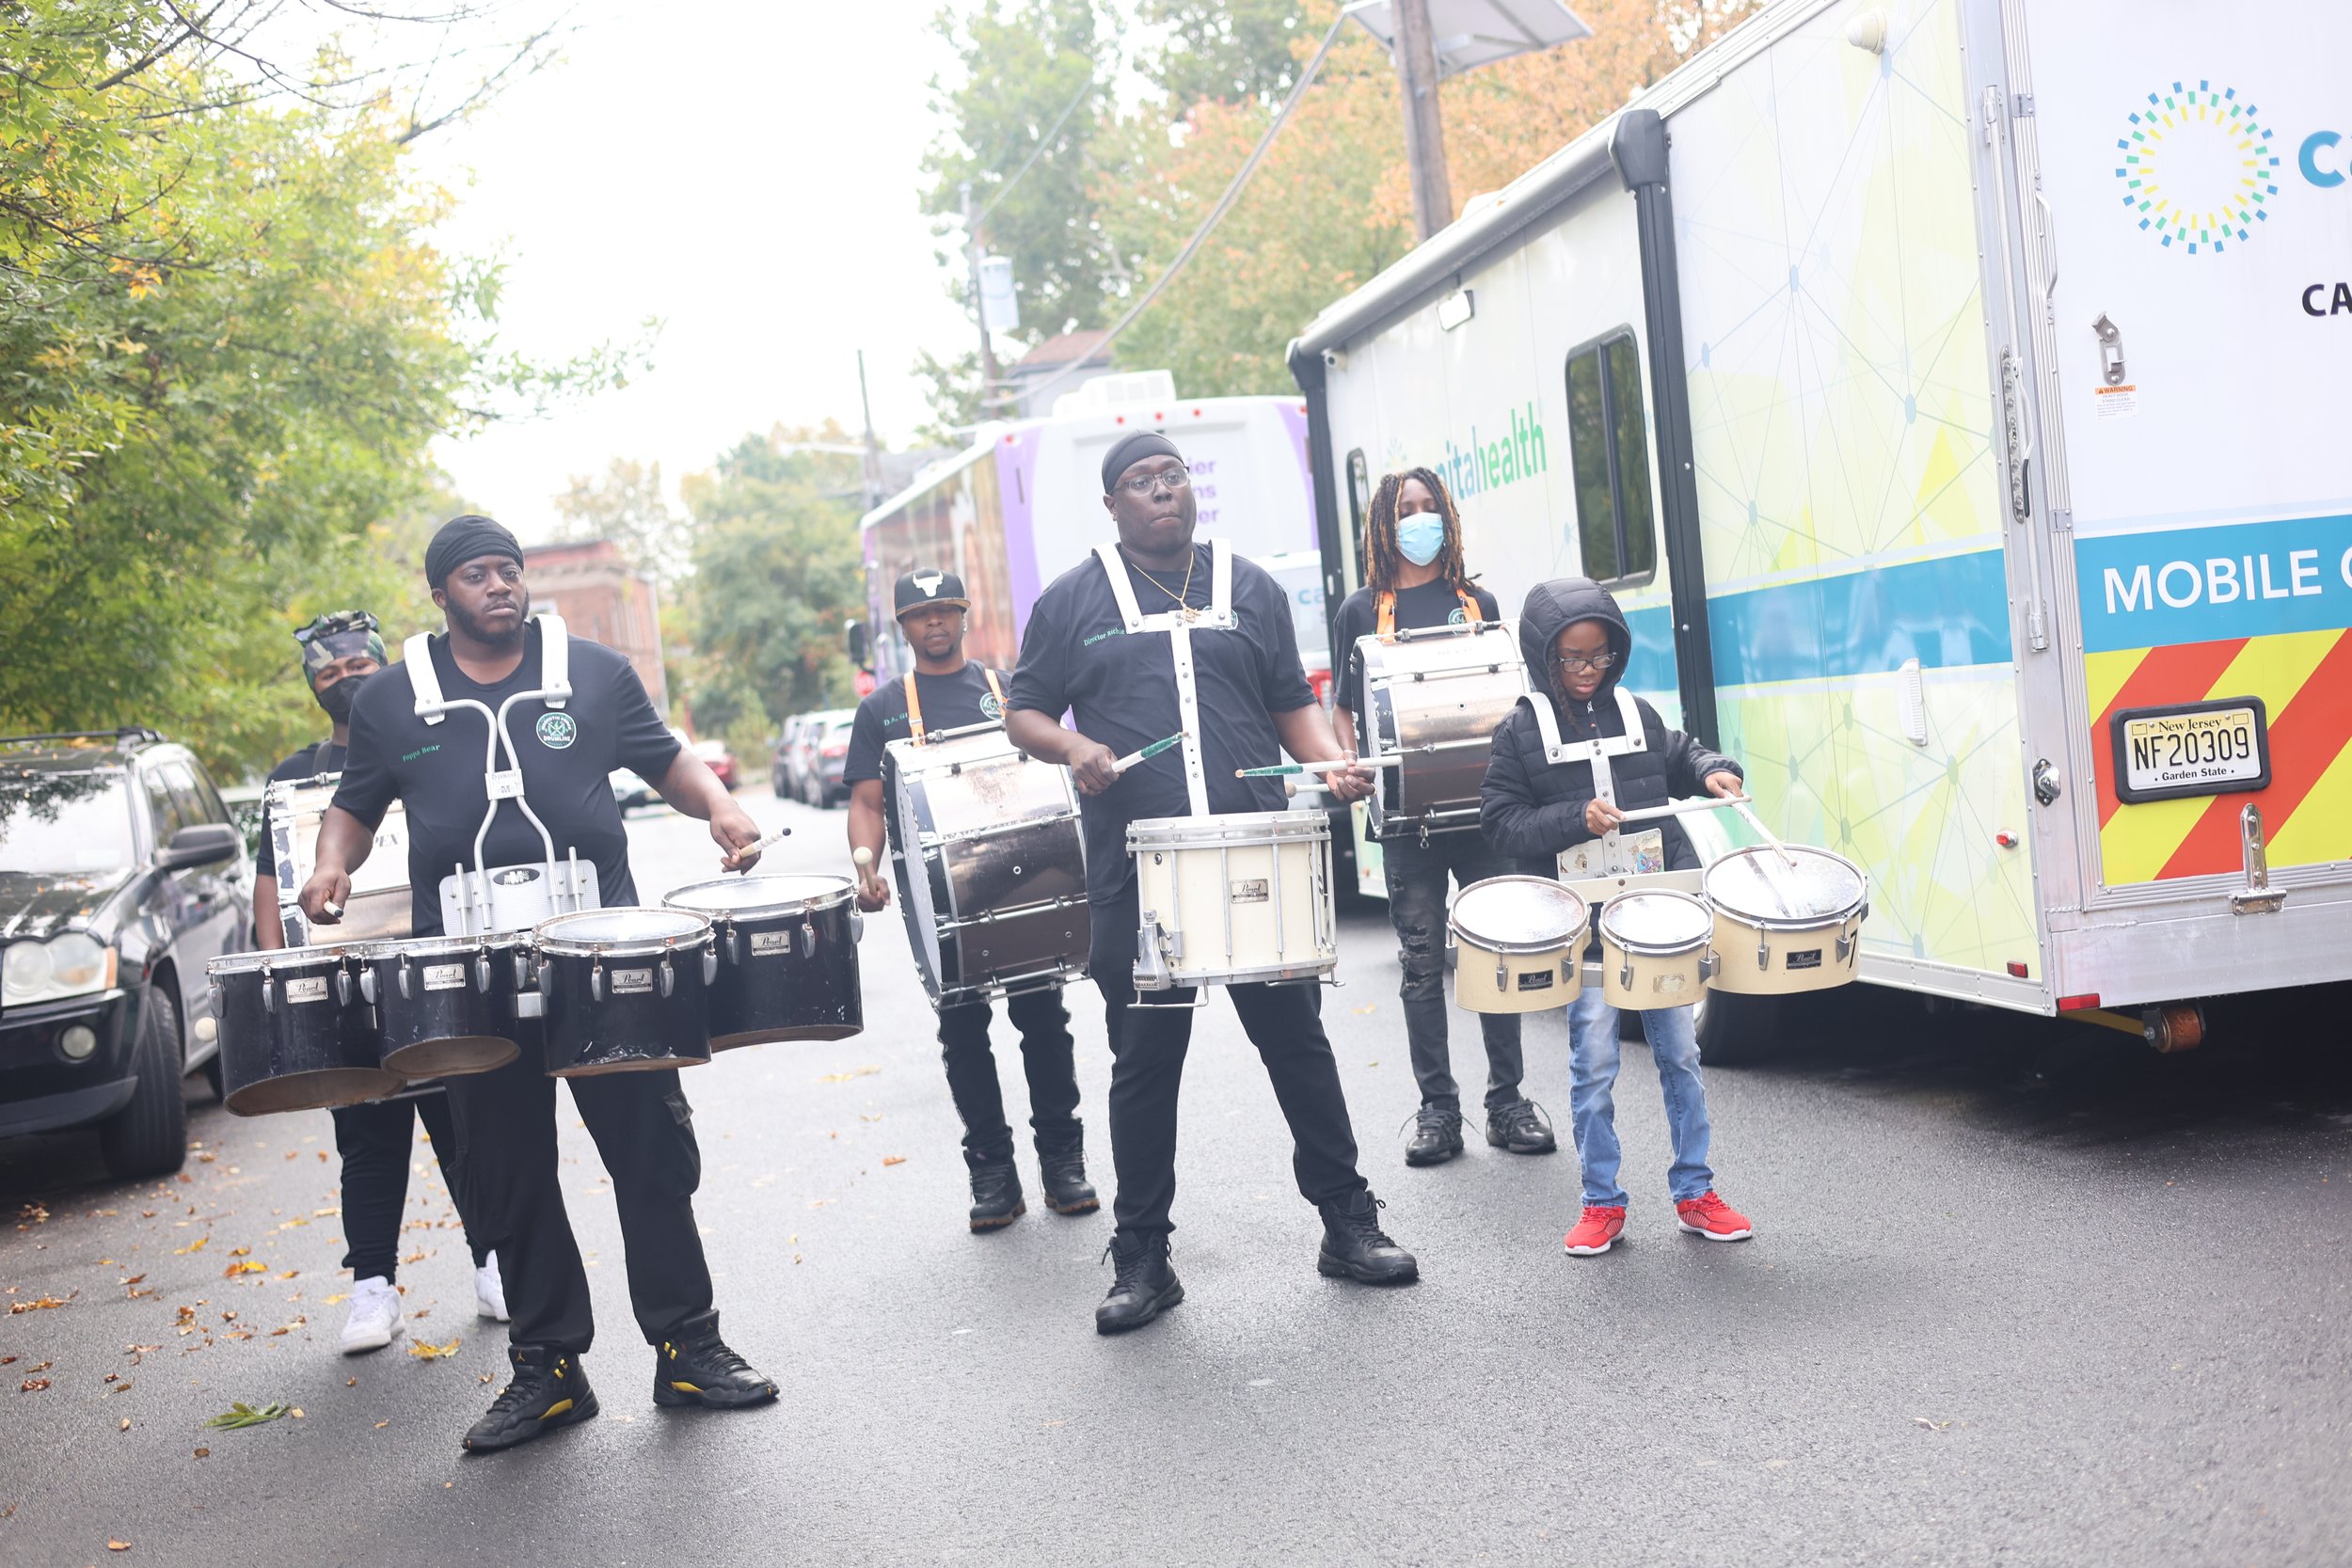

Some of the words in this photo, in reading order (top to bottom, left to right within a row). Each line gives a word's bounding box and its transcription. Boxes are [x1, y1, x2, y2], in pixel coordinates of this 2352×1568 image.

[2298, 130, 2352, 188] C
[2104, 549, 2322, 614] MOBILE
[1084, 634, 1106, 646] Director
[2158, 721, 2185, 733] New
[2186, 719, 2222, 732] Jersey
[2134, 727, 2249, 770] NF20309
[402, 750, 421, 763] Poppa
[2162, 770, 2198, 781] Garden
[2201, 767, 2227, 777] State
[762, 935, 782, 946] Pearl
[624, 973, 644, 984] Pearl
